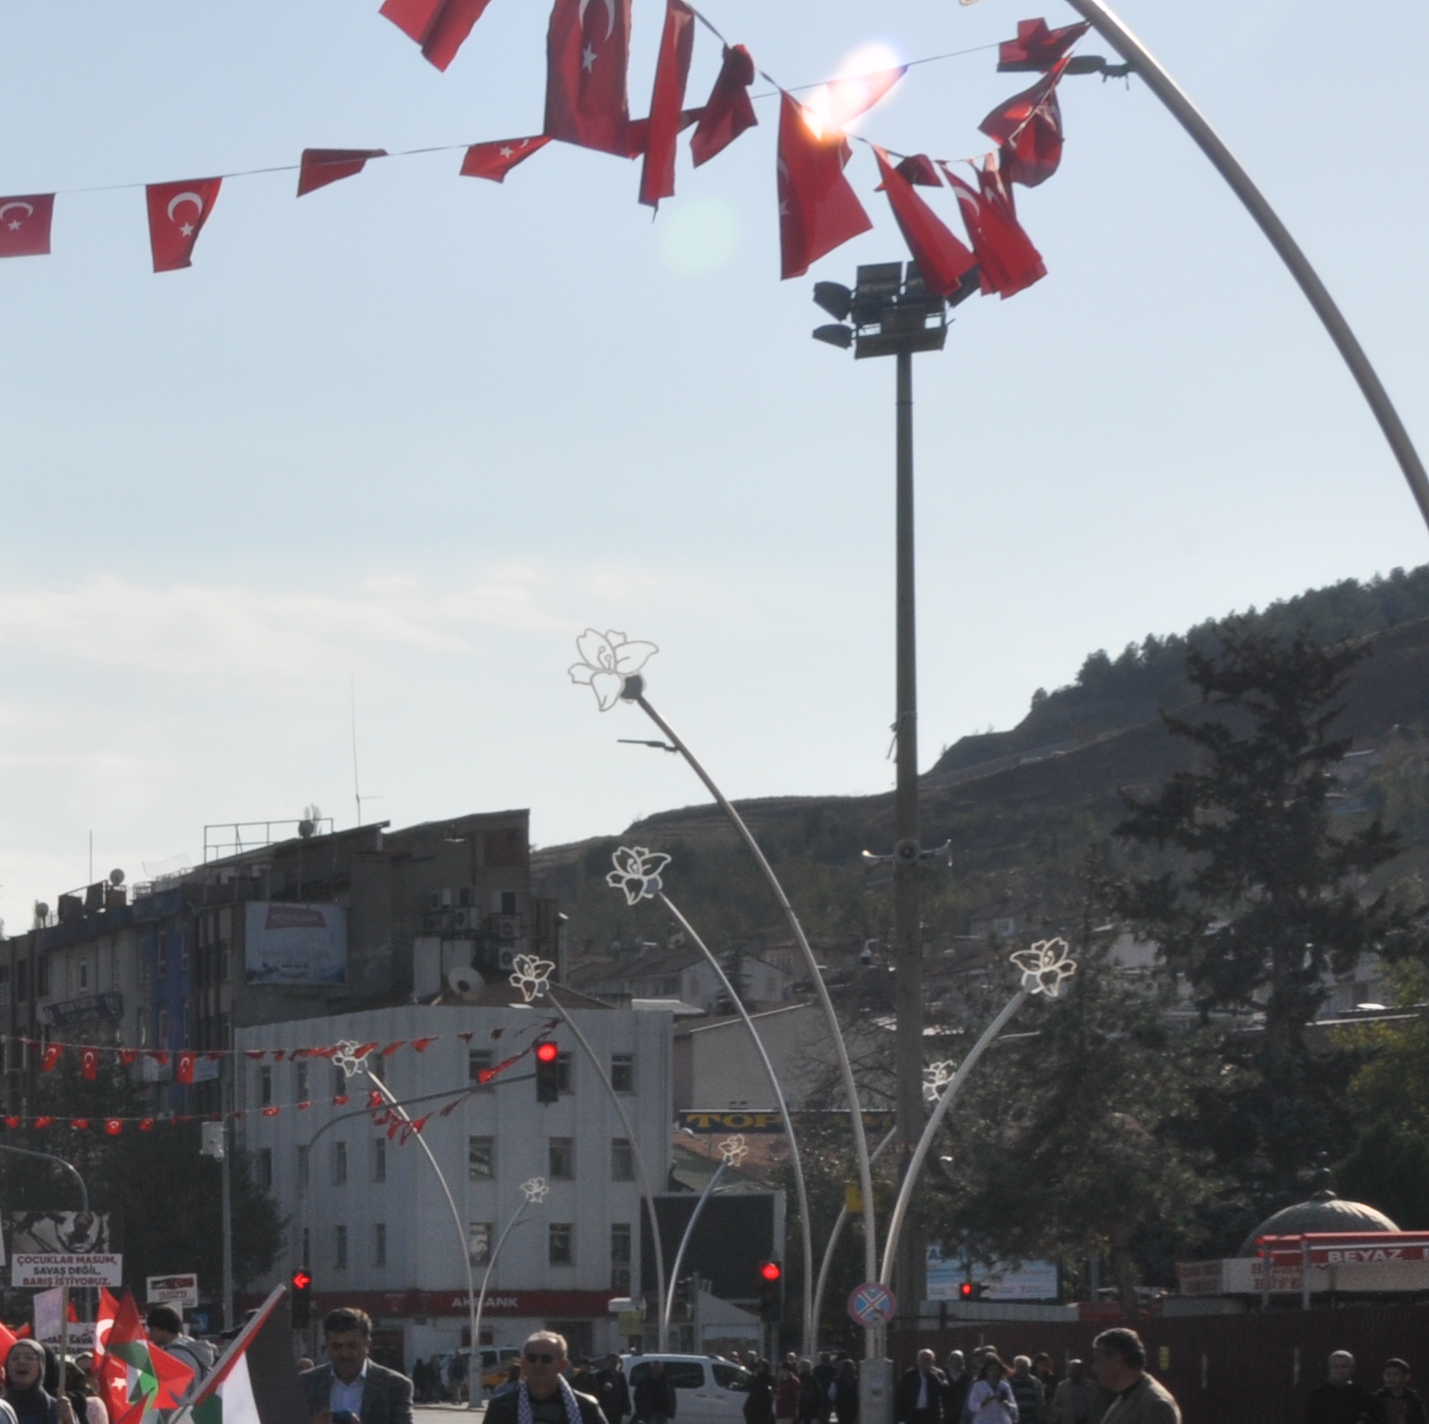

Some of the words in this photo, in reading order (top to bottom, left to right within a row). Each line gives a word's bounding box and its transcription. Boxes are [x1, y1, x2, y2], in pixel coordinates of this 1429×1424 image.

[17, 1255, 73, 1267] ÇOCUKLAR
[1328, 1249, 1403, 1262] BEYAZ
[33, 1266, 66, 1276] SAVAŞ
